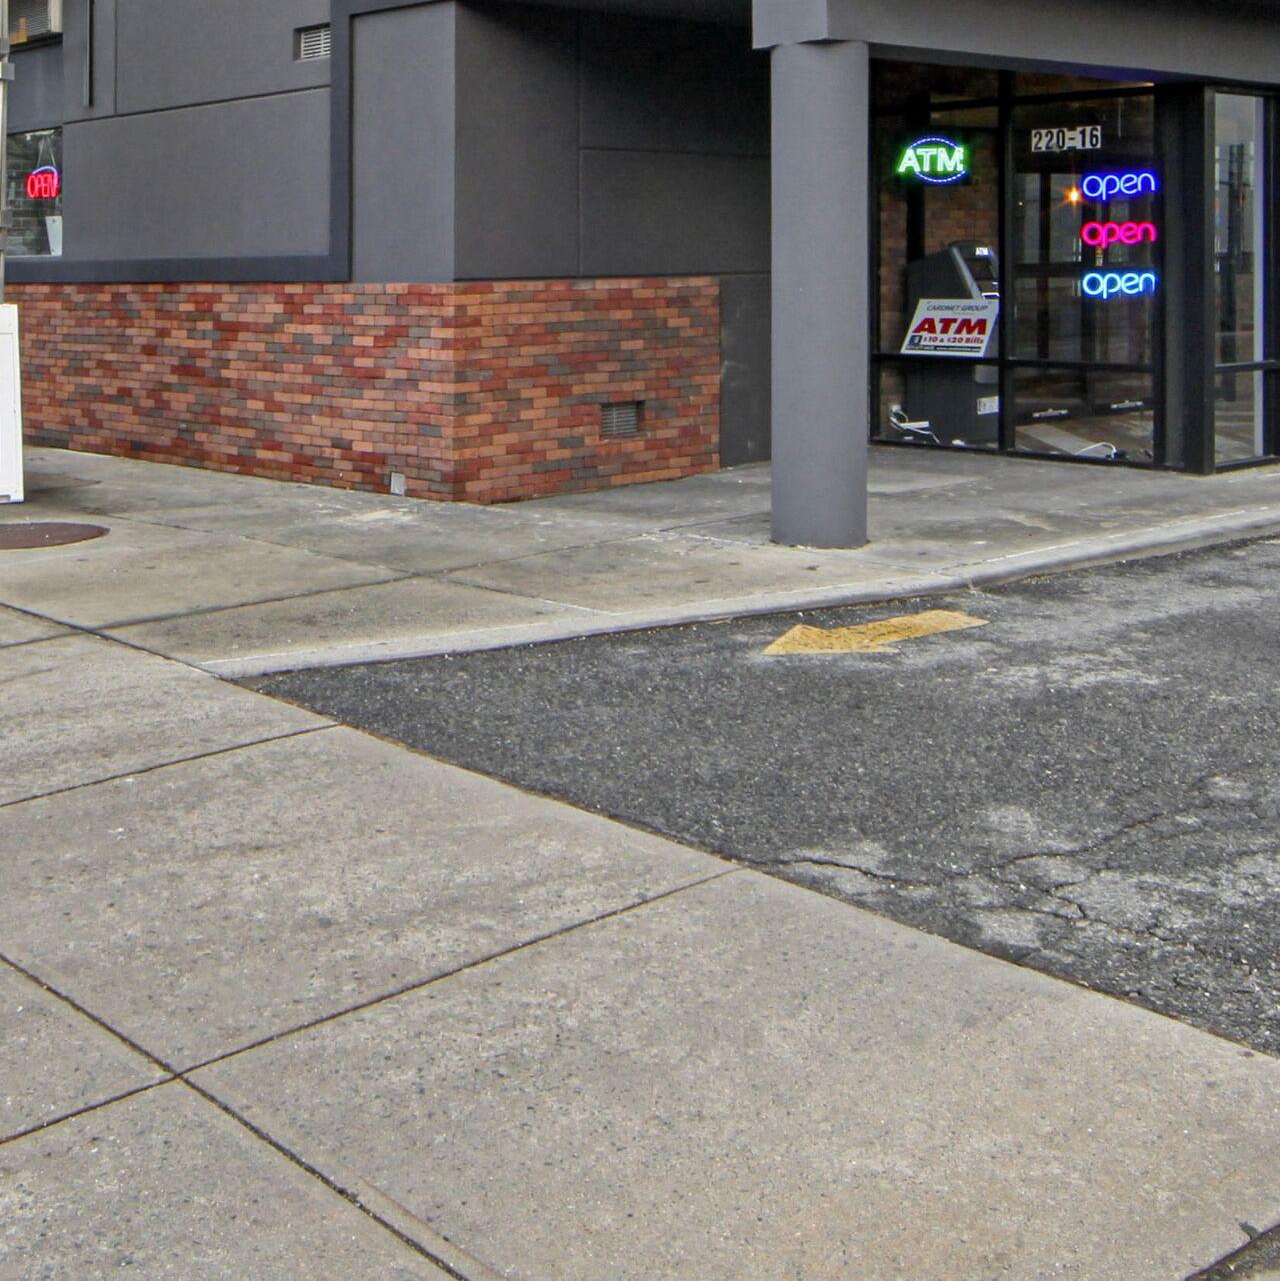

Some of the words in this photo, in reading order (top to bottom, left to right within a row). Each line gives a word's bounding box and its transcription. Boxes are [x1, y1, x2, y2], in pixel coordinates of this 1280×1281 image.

[1032, 128, 1100, 150] 220-16
[898, 147, 964, 172] ATM
[27, 173, 58, 198] OPEN
[1082, 173, 1155, 201] open
[1080, 221, 1157, 249] open
[1082, 272, 1156, 299] open
[913, 318, 988, 335] ATM
